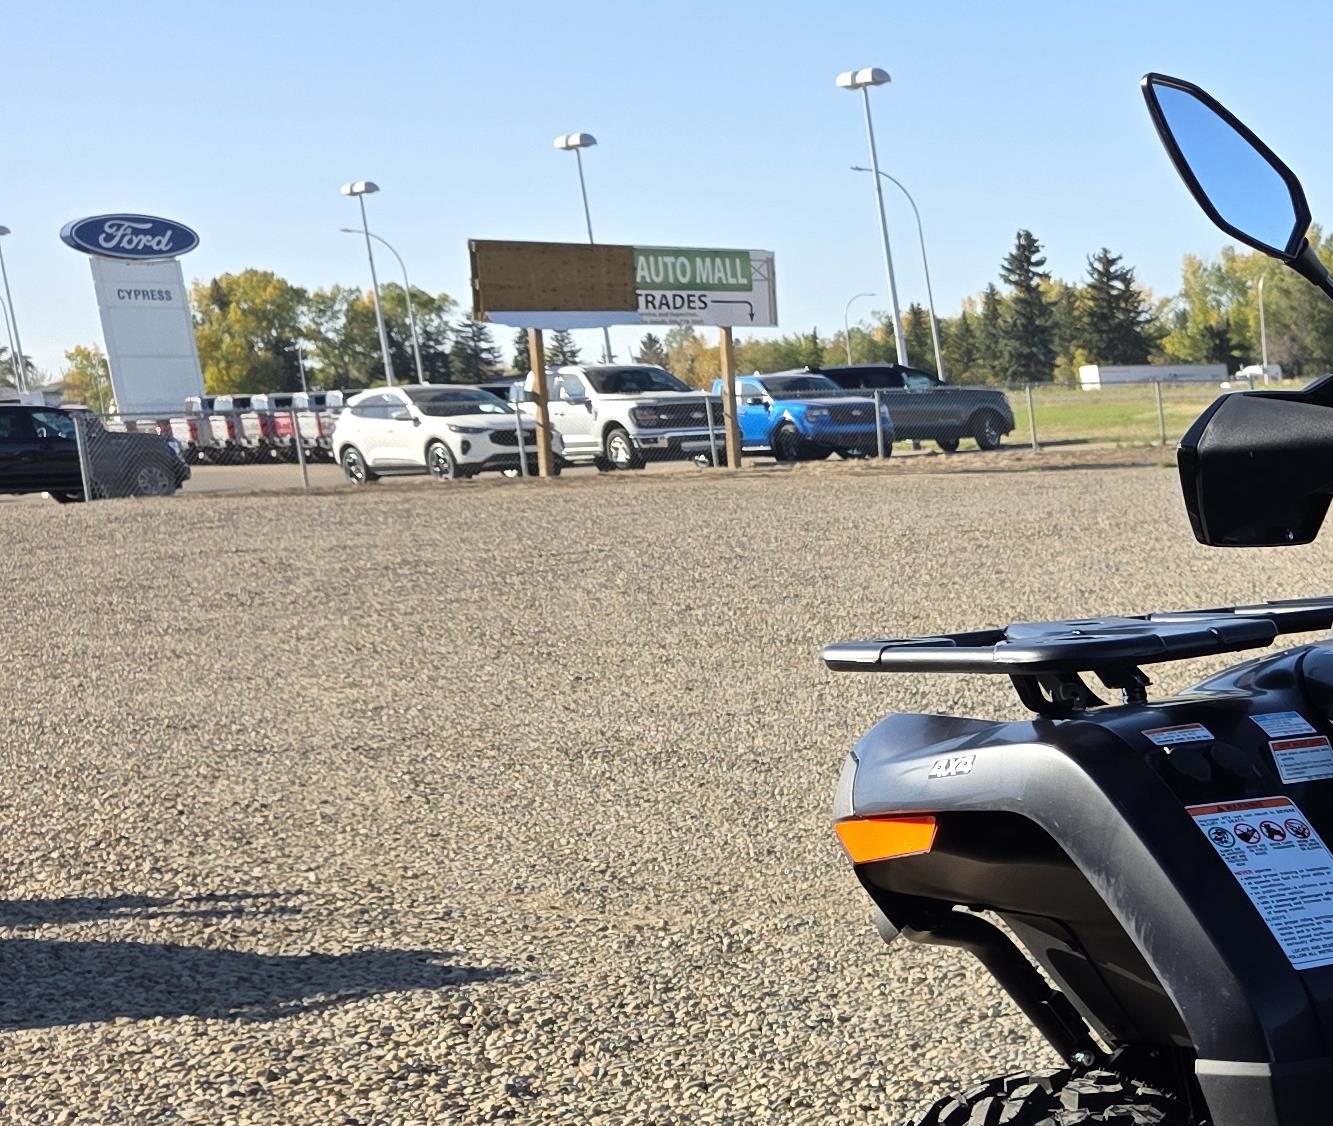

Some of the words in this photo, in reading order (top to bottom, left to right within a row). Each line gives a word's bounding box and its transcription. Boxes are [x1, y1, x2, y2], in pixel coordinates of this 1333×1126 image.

[98, 220, 173, 251] Ford
[636, 255, 691, 284] AUTO
[695, 257, 748, 284] MALL
[117, 288, 172, 301] CYPRESS
